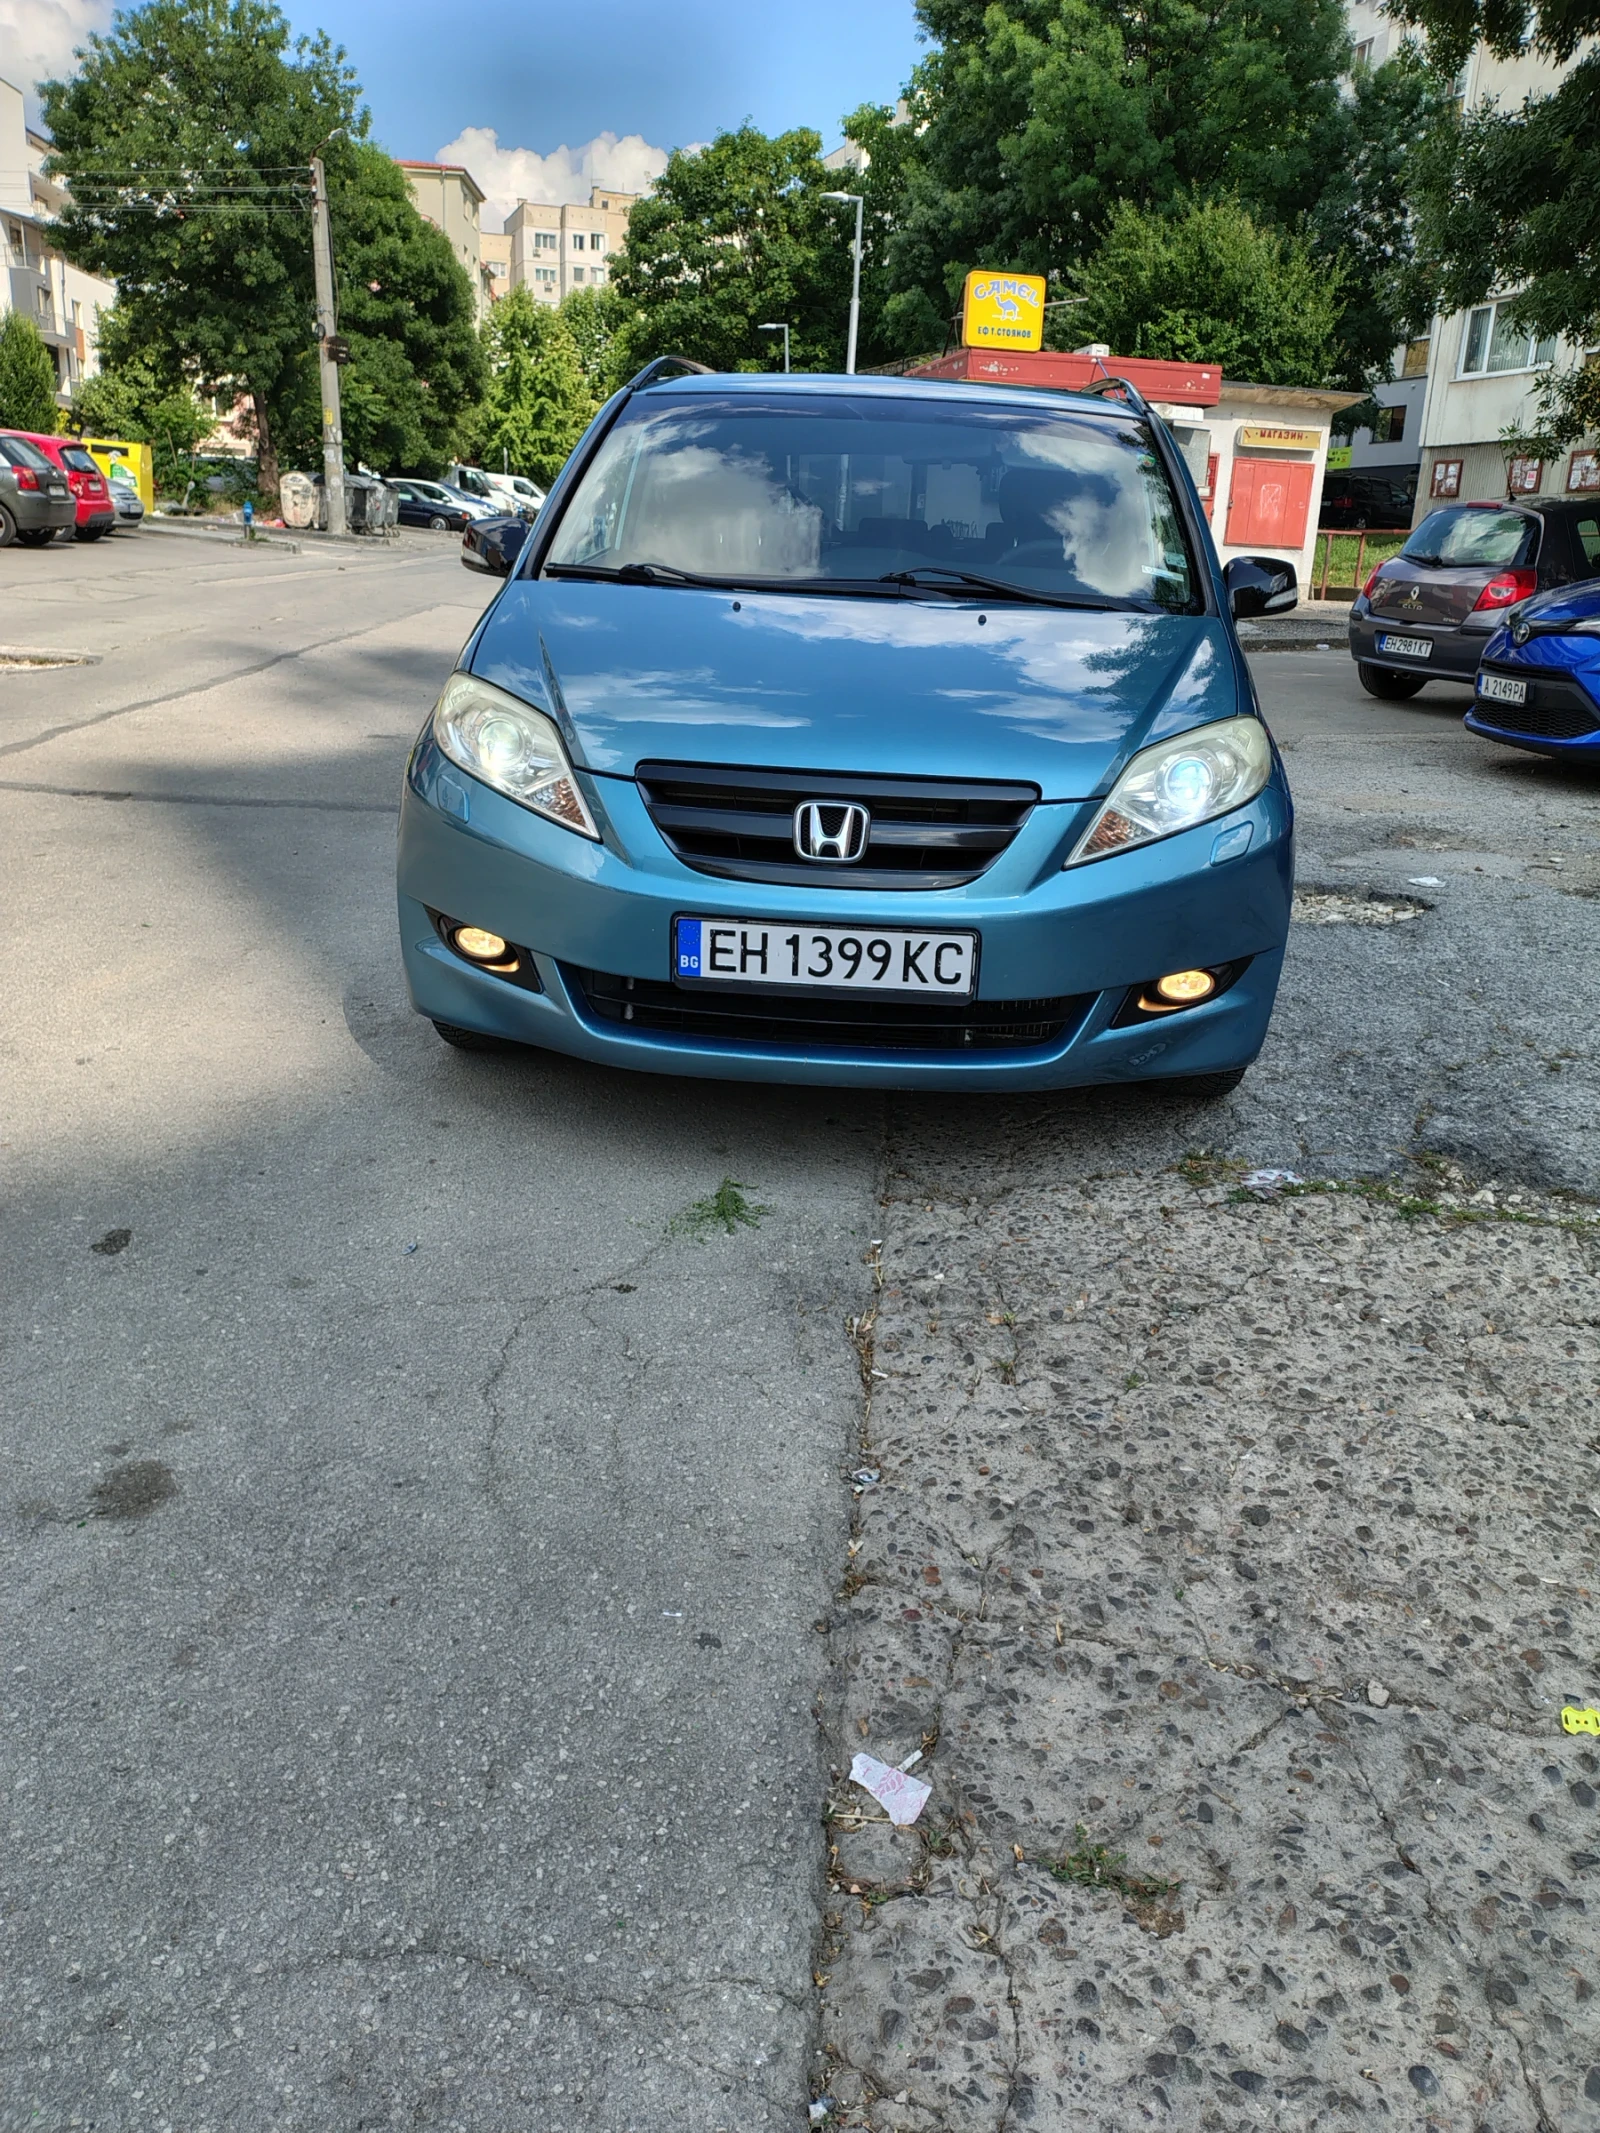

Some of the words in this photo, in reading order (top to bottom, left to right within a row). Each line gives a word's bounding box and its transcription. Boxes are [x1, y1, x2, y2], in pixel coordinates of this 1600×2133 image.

[974, 279, 1039, 307] CAMEL
[1260, 429, 1303, 441] МАГАЗИН
[680, 954, 699, 968] BG
